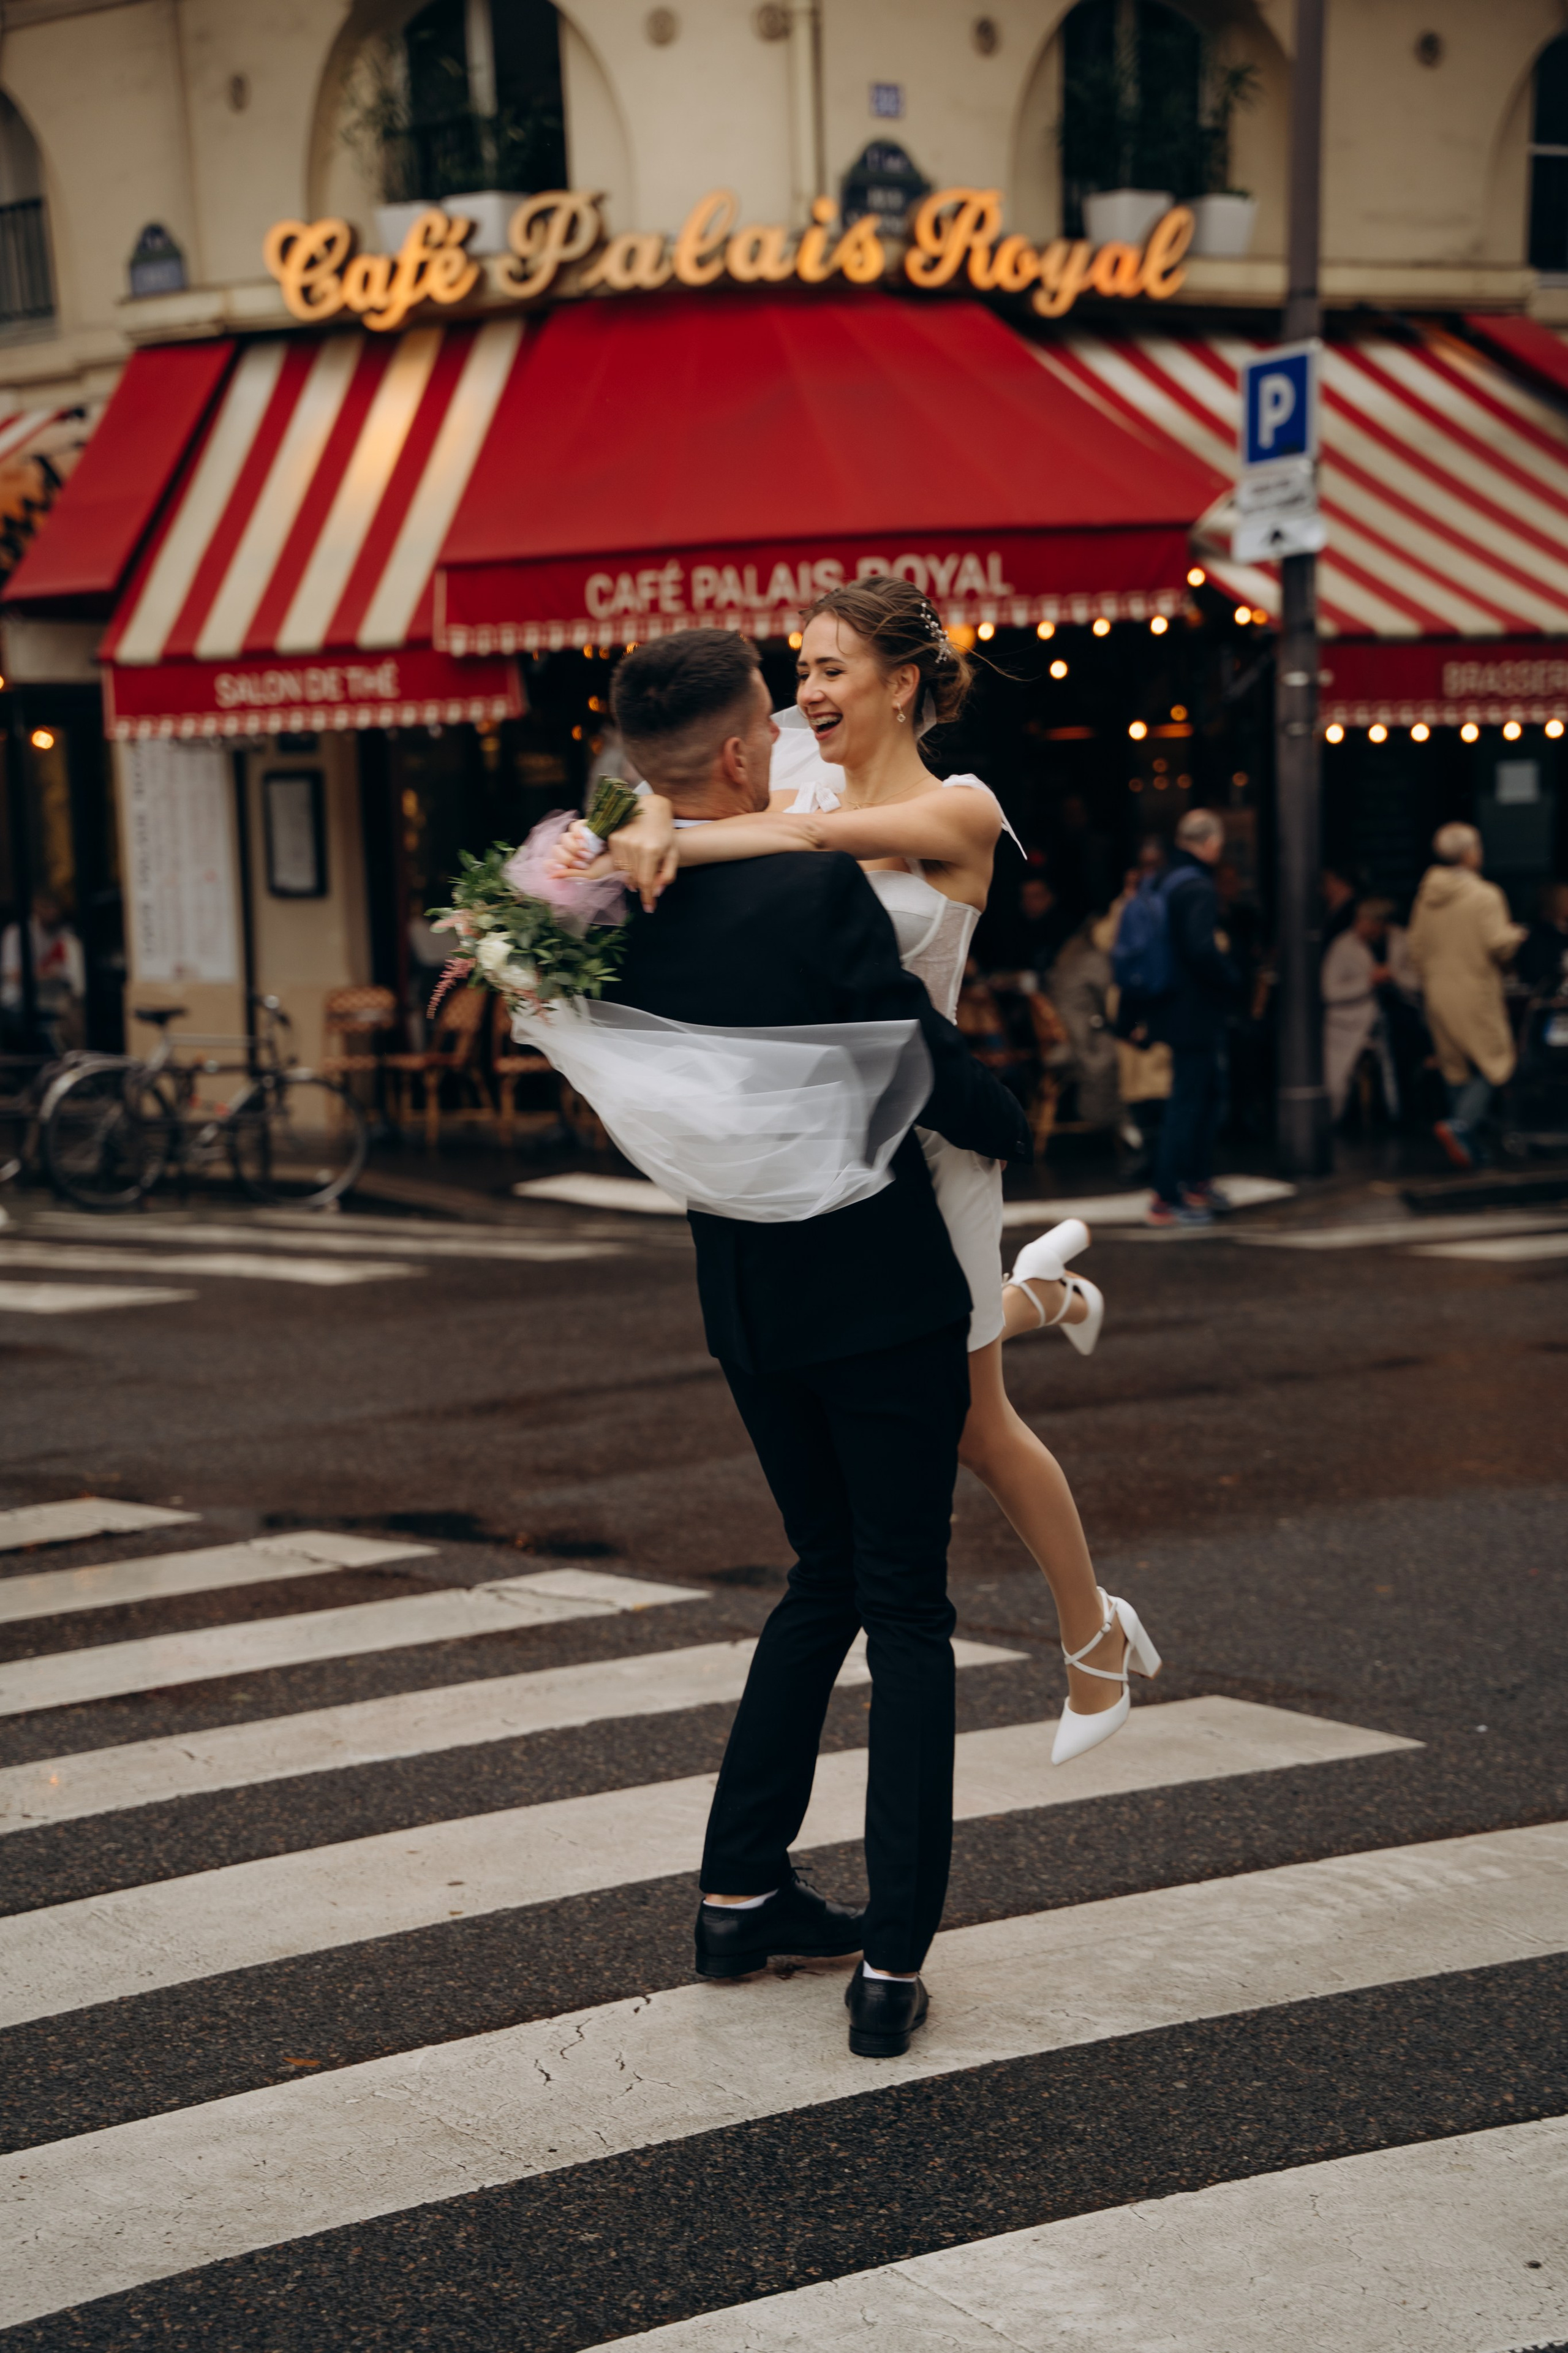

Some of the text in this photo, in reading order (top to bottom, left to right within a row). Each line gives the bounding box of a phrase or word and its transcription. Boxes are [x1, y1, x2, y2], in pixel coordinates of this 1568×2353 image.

[263, 187, 1194, 331] Café Palais Royal
[1257, 373, 1296, 449] P
[584, 559, 685, 620] CAFÉ
[691, 557, 845, 612] PALAIS
[216, 657, 400, 708] SALON DE THÉ
